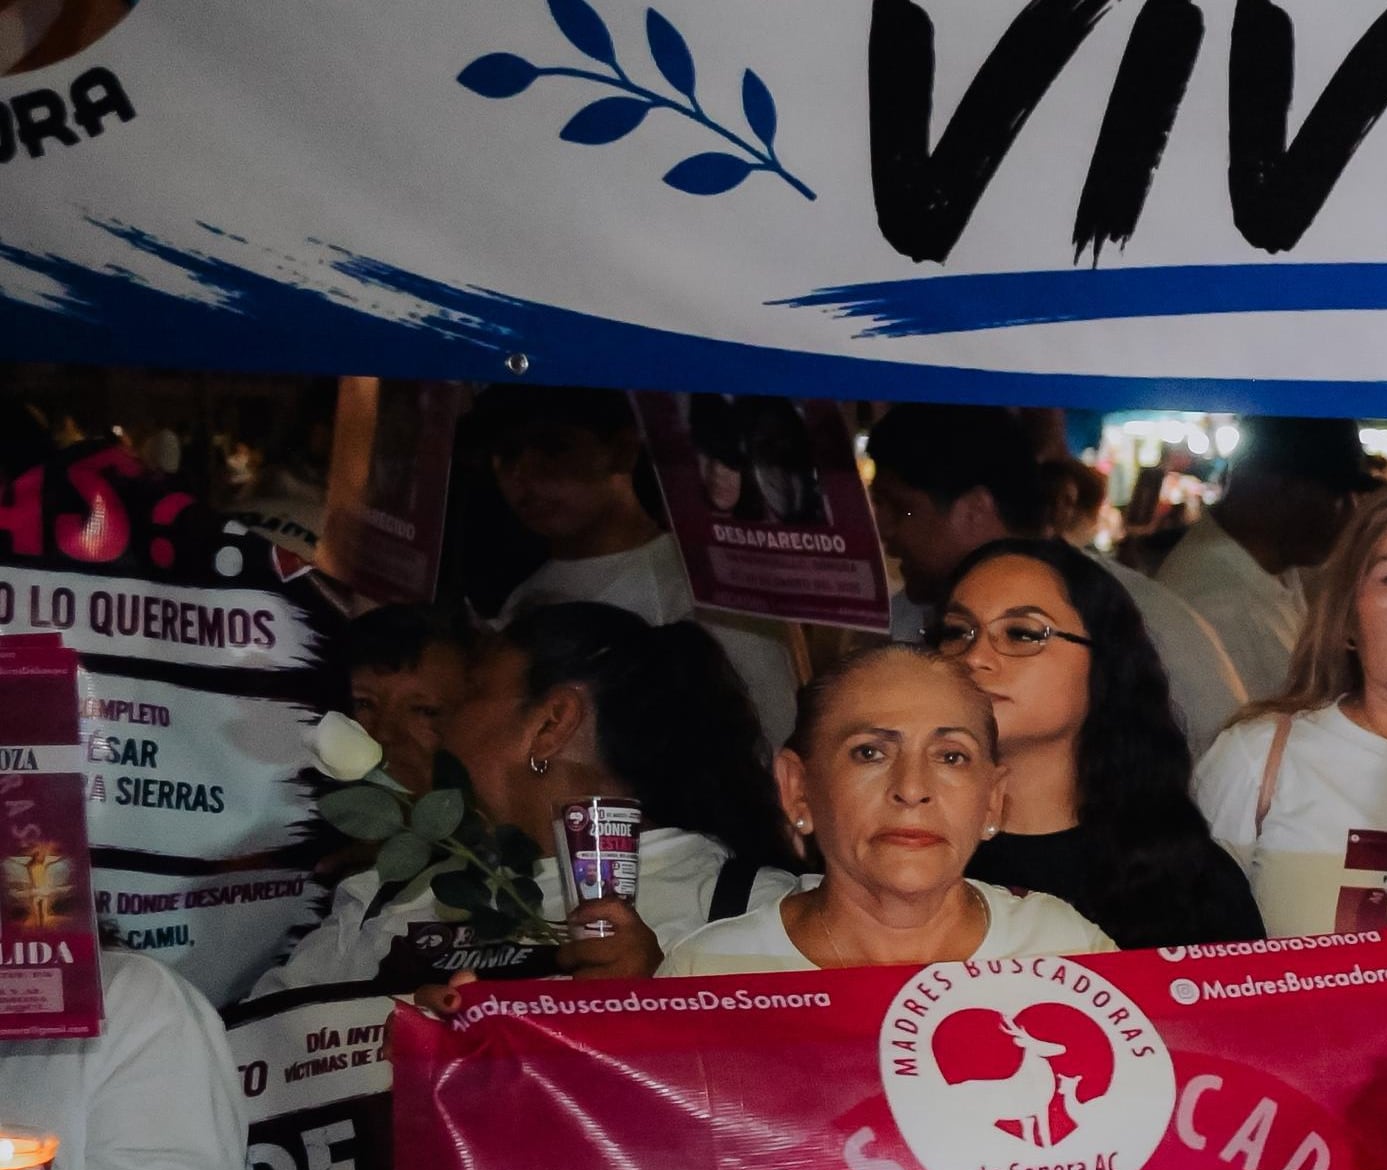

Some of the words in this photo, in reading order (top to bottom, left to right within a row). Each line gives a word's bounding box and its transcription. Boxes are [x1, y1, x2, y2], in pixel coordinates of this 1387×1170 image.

[712, 524, 847, 553] DESAPARECIDO
[30, 584, 76, 631] LO
[90, 590, 277, 650] QUEREMOS
[115, 776, 225, 814] SIERRAS
[117, 892, 179, 915] DONDE
[306, 1026, 341, 1054] DÍA
[894, 970, 953, 1077] MADRES
[284, 1052, 348, 1084] VÍCTIMAS
[351, 1048, 374, 1068] DE
